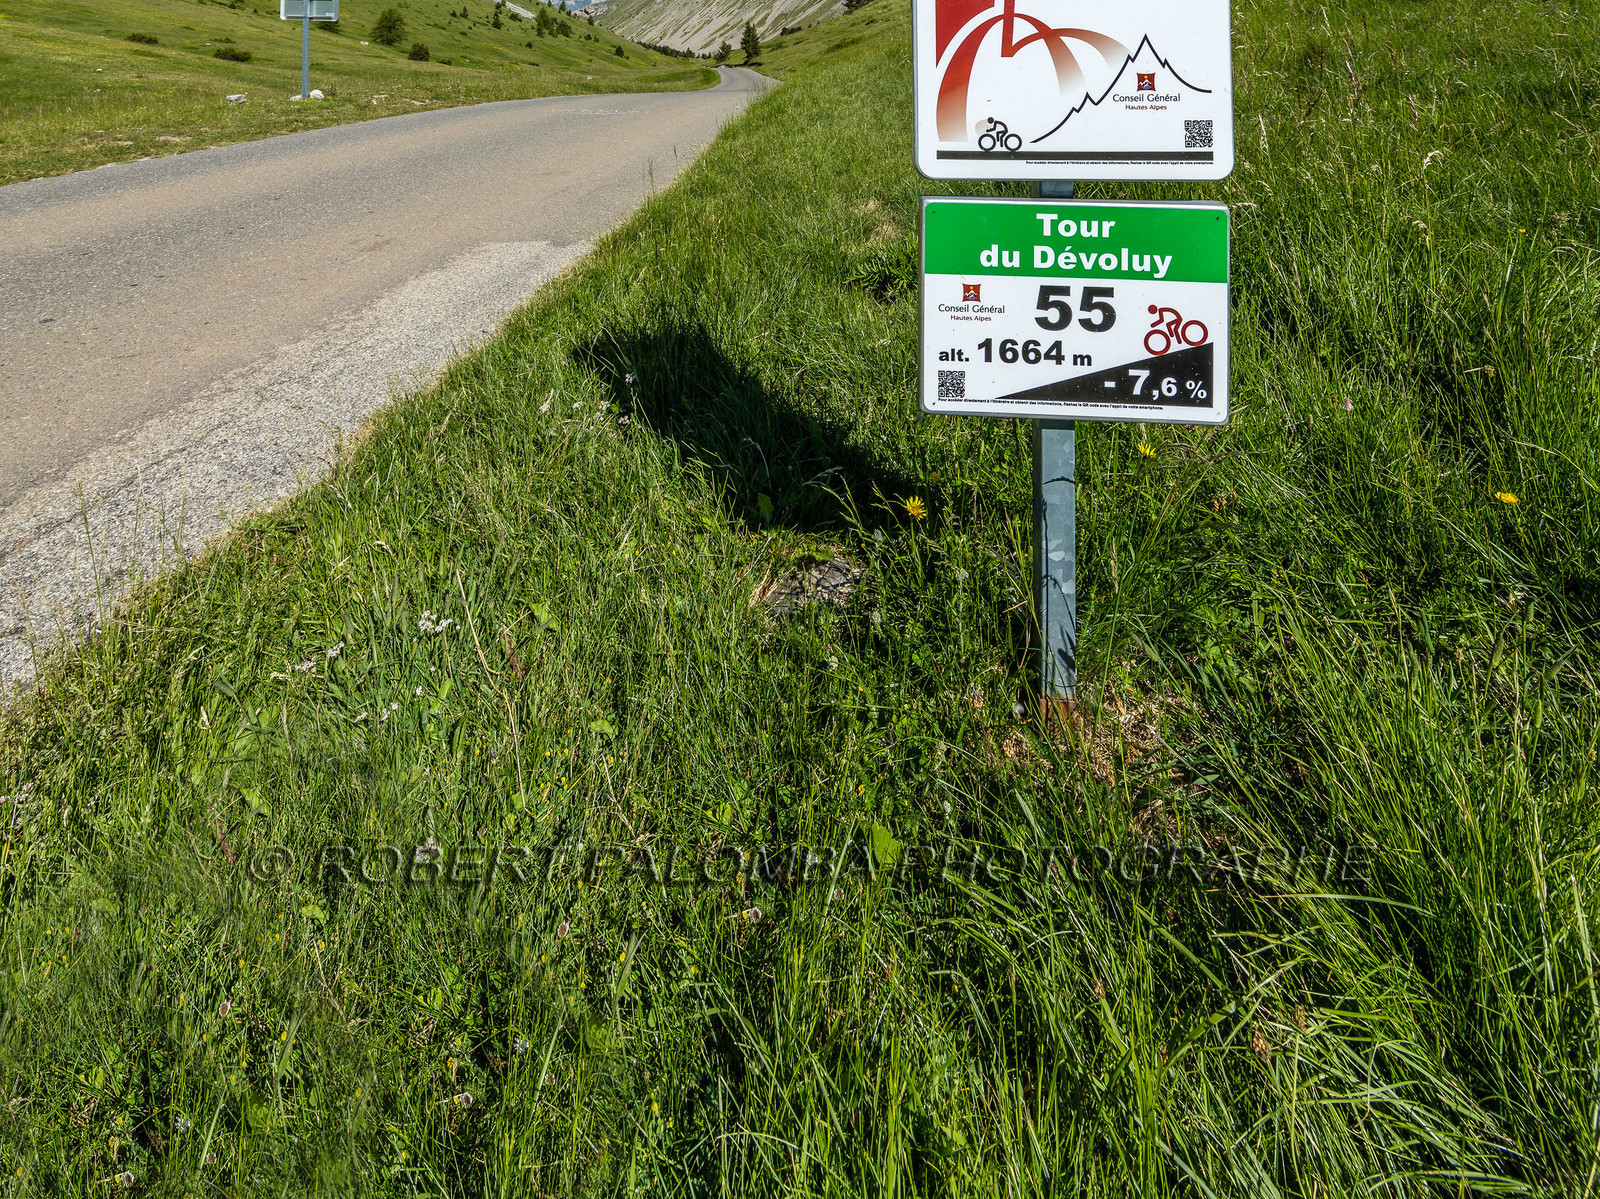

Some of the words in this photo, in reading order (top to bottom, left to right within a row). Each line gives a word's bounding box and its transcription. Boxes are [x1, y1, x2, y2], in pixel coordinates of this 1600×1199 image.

[1112, 93, 1144, 102] Conseil
[1146, 92, 1181, 102] Général
[1036, 213, 1116, 238] Tour
[979, 244, 1020, 268] du
[1033, 245, 1173, 279] Dévoluy
[938, 303, 970, 313] Conseil
[971, 304, 1005, 314] Général
[1034, 284, 1117, 333] 55
[938, 347, 970, 363] alt.
[977, 337, 1066, 366] 1664
[1072, 353, 1092, 367] m
[1128, 368, 1177, 400] 7,6
[1185, 380, 1207, 399] %
